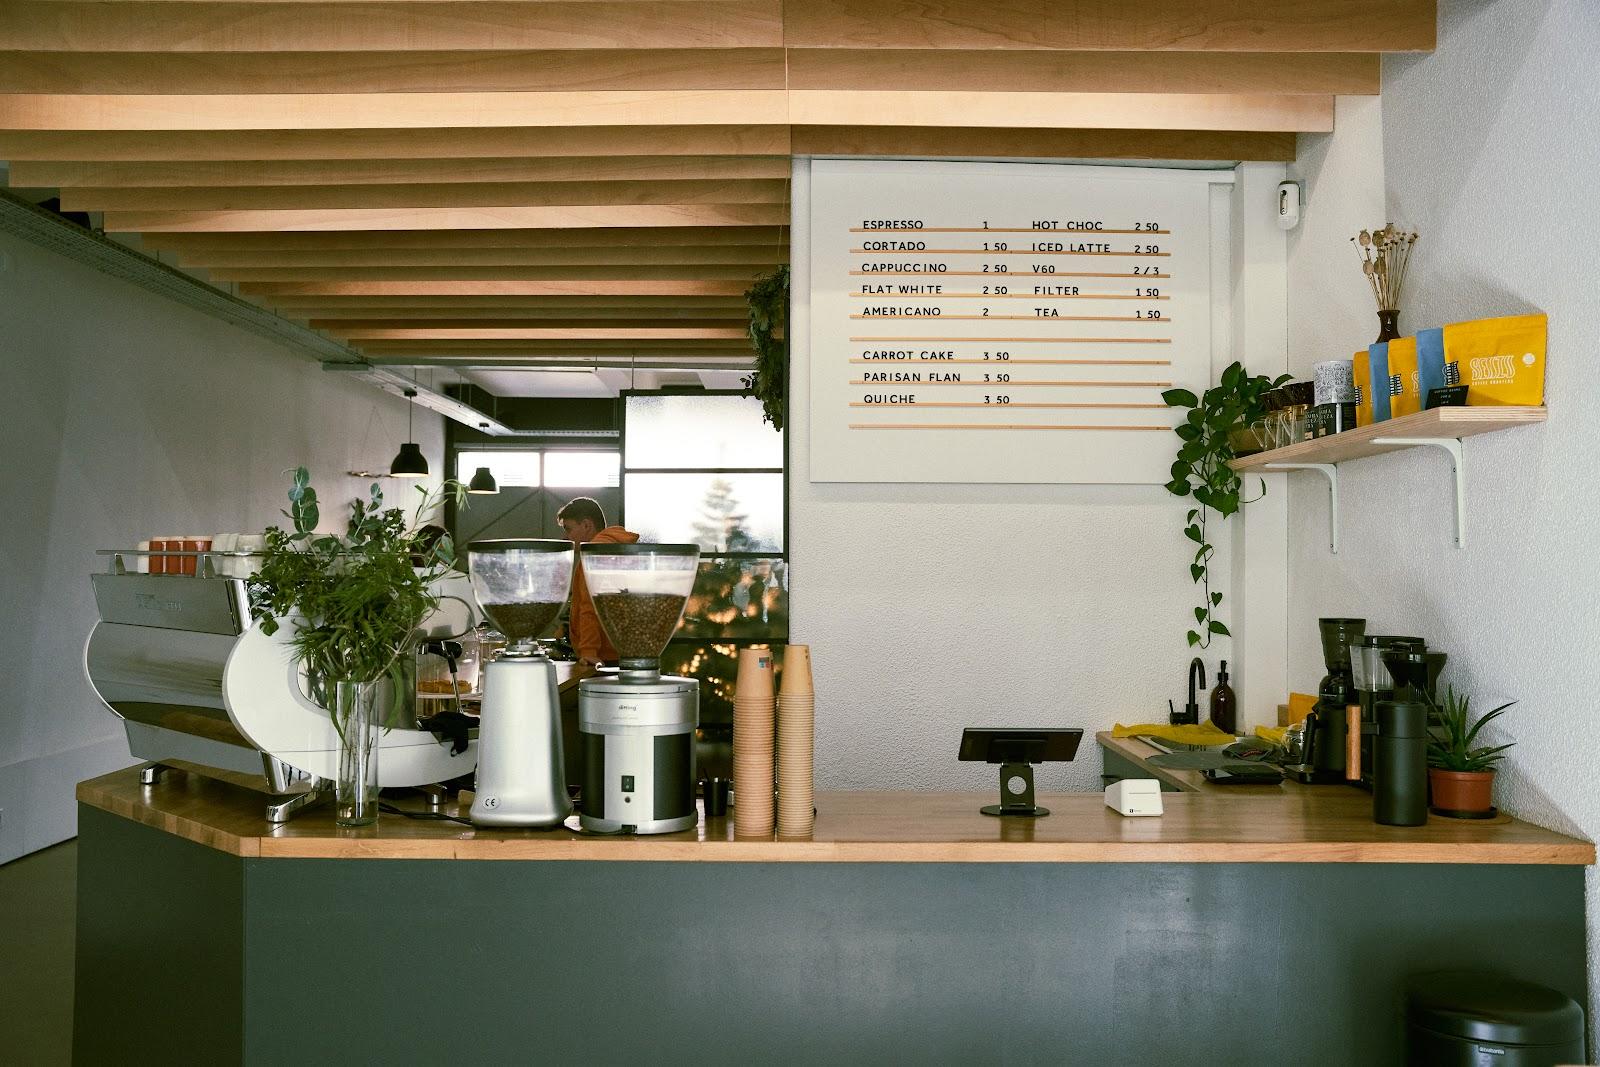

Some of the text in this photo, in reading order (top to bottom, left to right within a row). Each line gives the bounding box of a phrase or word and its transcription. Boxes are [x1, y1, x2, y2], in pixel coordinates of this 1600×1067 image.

[863, 220, 989, 230] ESPRESSO 1
[1032, 220, 1159, 232] HOT CHOC 2 50
[863, 241, 1008, 252] CORTADO 1 50
[1032, 242, 1159, 255] ICED LATTE 2 50
[861, 263, 1008, 273] CAPPUCCINO 2 50
[1032, 264, 1055, 274] V60
[862, 284, 1008, 295] FLAT WHITE 2 50
[1034, 286, 1159, 297] FILTER 1 50
[862, 307, 989, 317] AMERICANO 2
[1034, 308, 1161, 319] TEA 1 50
[862, 350, 1010, 361] CARROT CAKE 3 50
[863, 372, 1010, 383] PARISAN FLAN 3 50
[863, 394, 1010, 405] QUICHE 3 50
